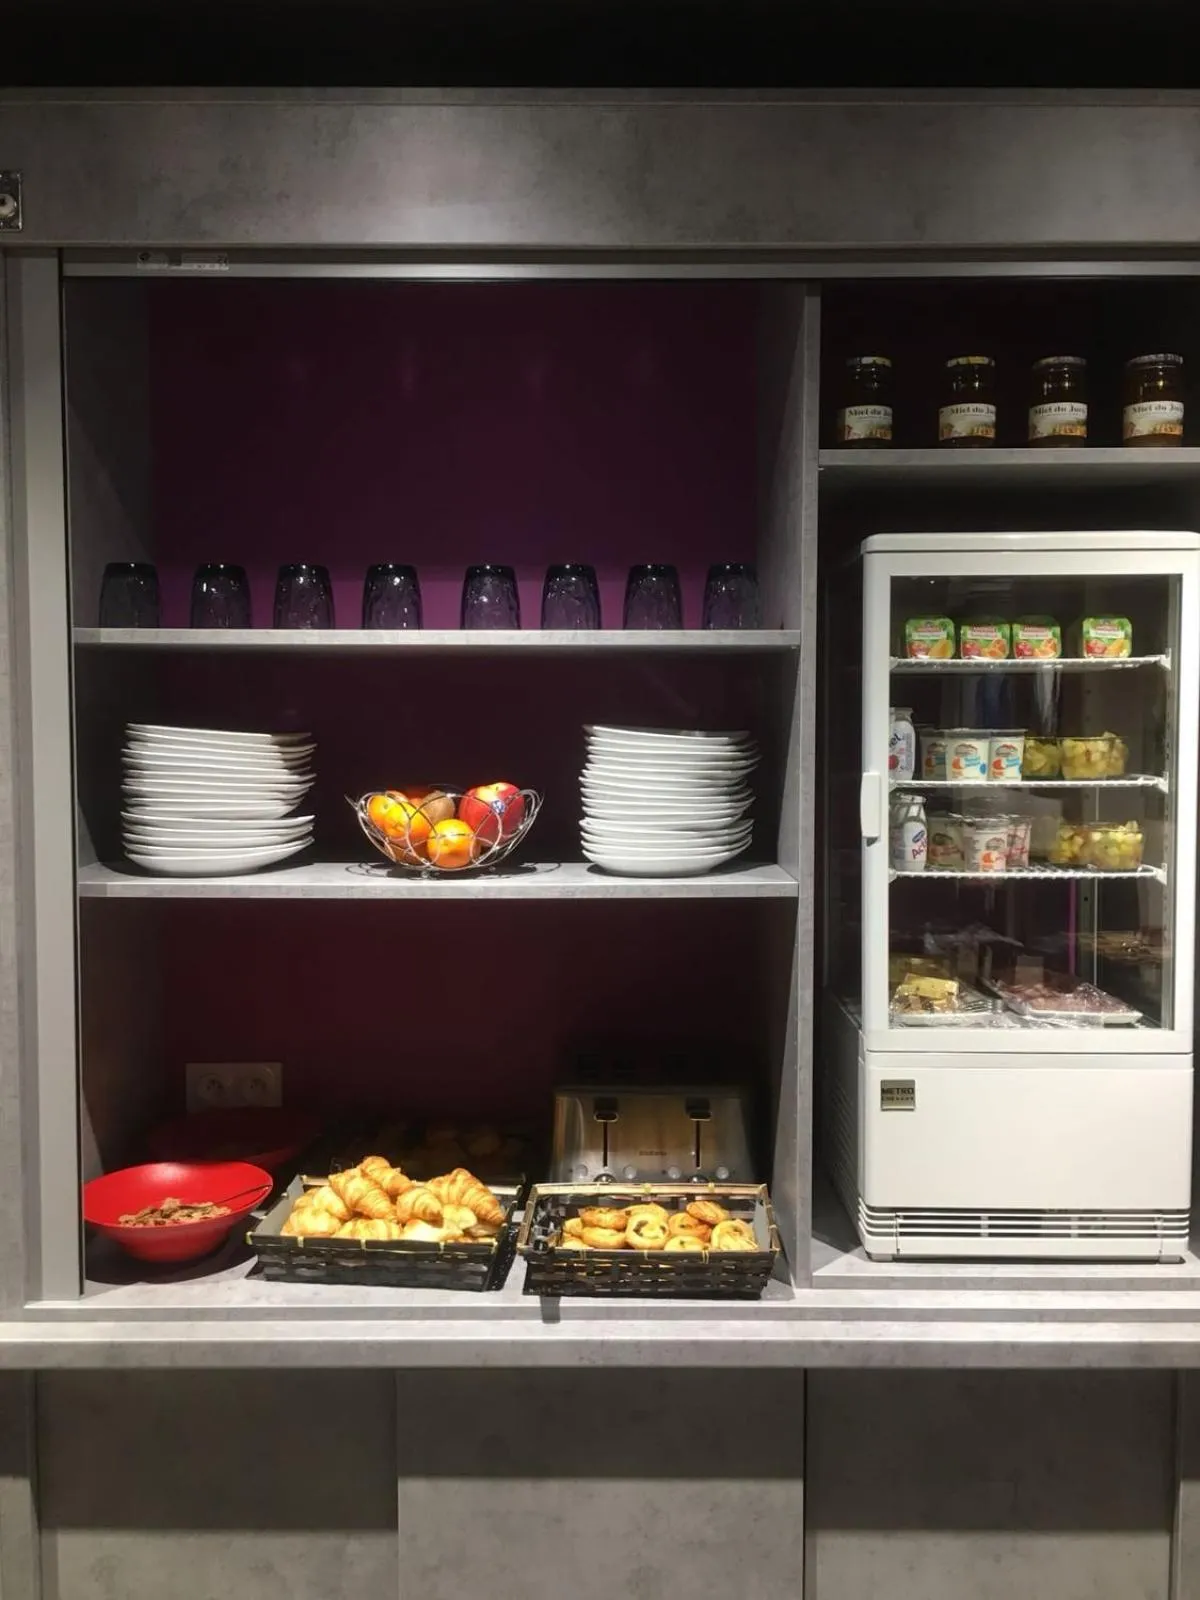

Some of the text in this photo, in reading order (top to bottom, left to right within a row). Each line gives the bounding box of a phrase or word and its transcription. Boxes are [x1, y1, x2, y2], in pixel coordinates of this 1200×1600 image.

[950, 406, 970, 414] Miel
[972, 405, 984, 413] du
[1035, 406, 1053, 415] Miel
[1055, 405, 1067, 413] du
[1132, 403, 1152, 412] Miel
[1154, 403, 1167, 411] du
[848, 408, 869, 417] Miel
[881, 1087, 915, 1095] METRO
